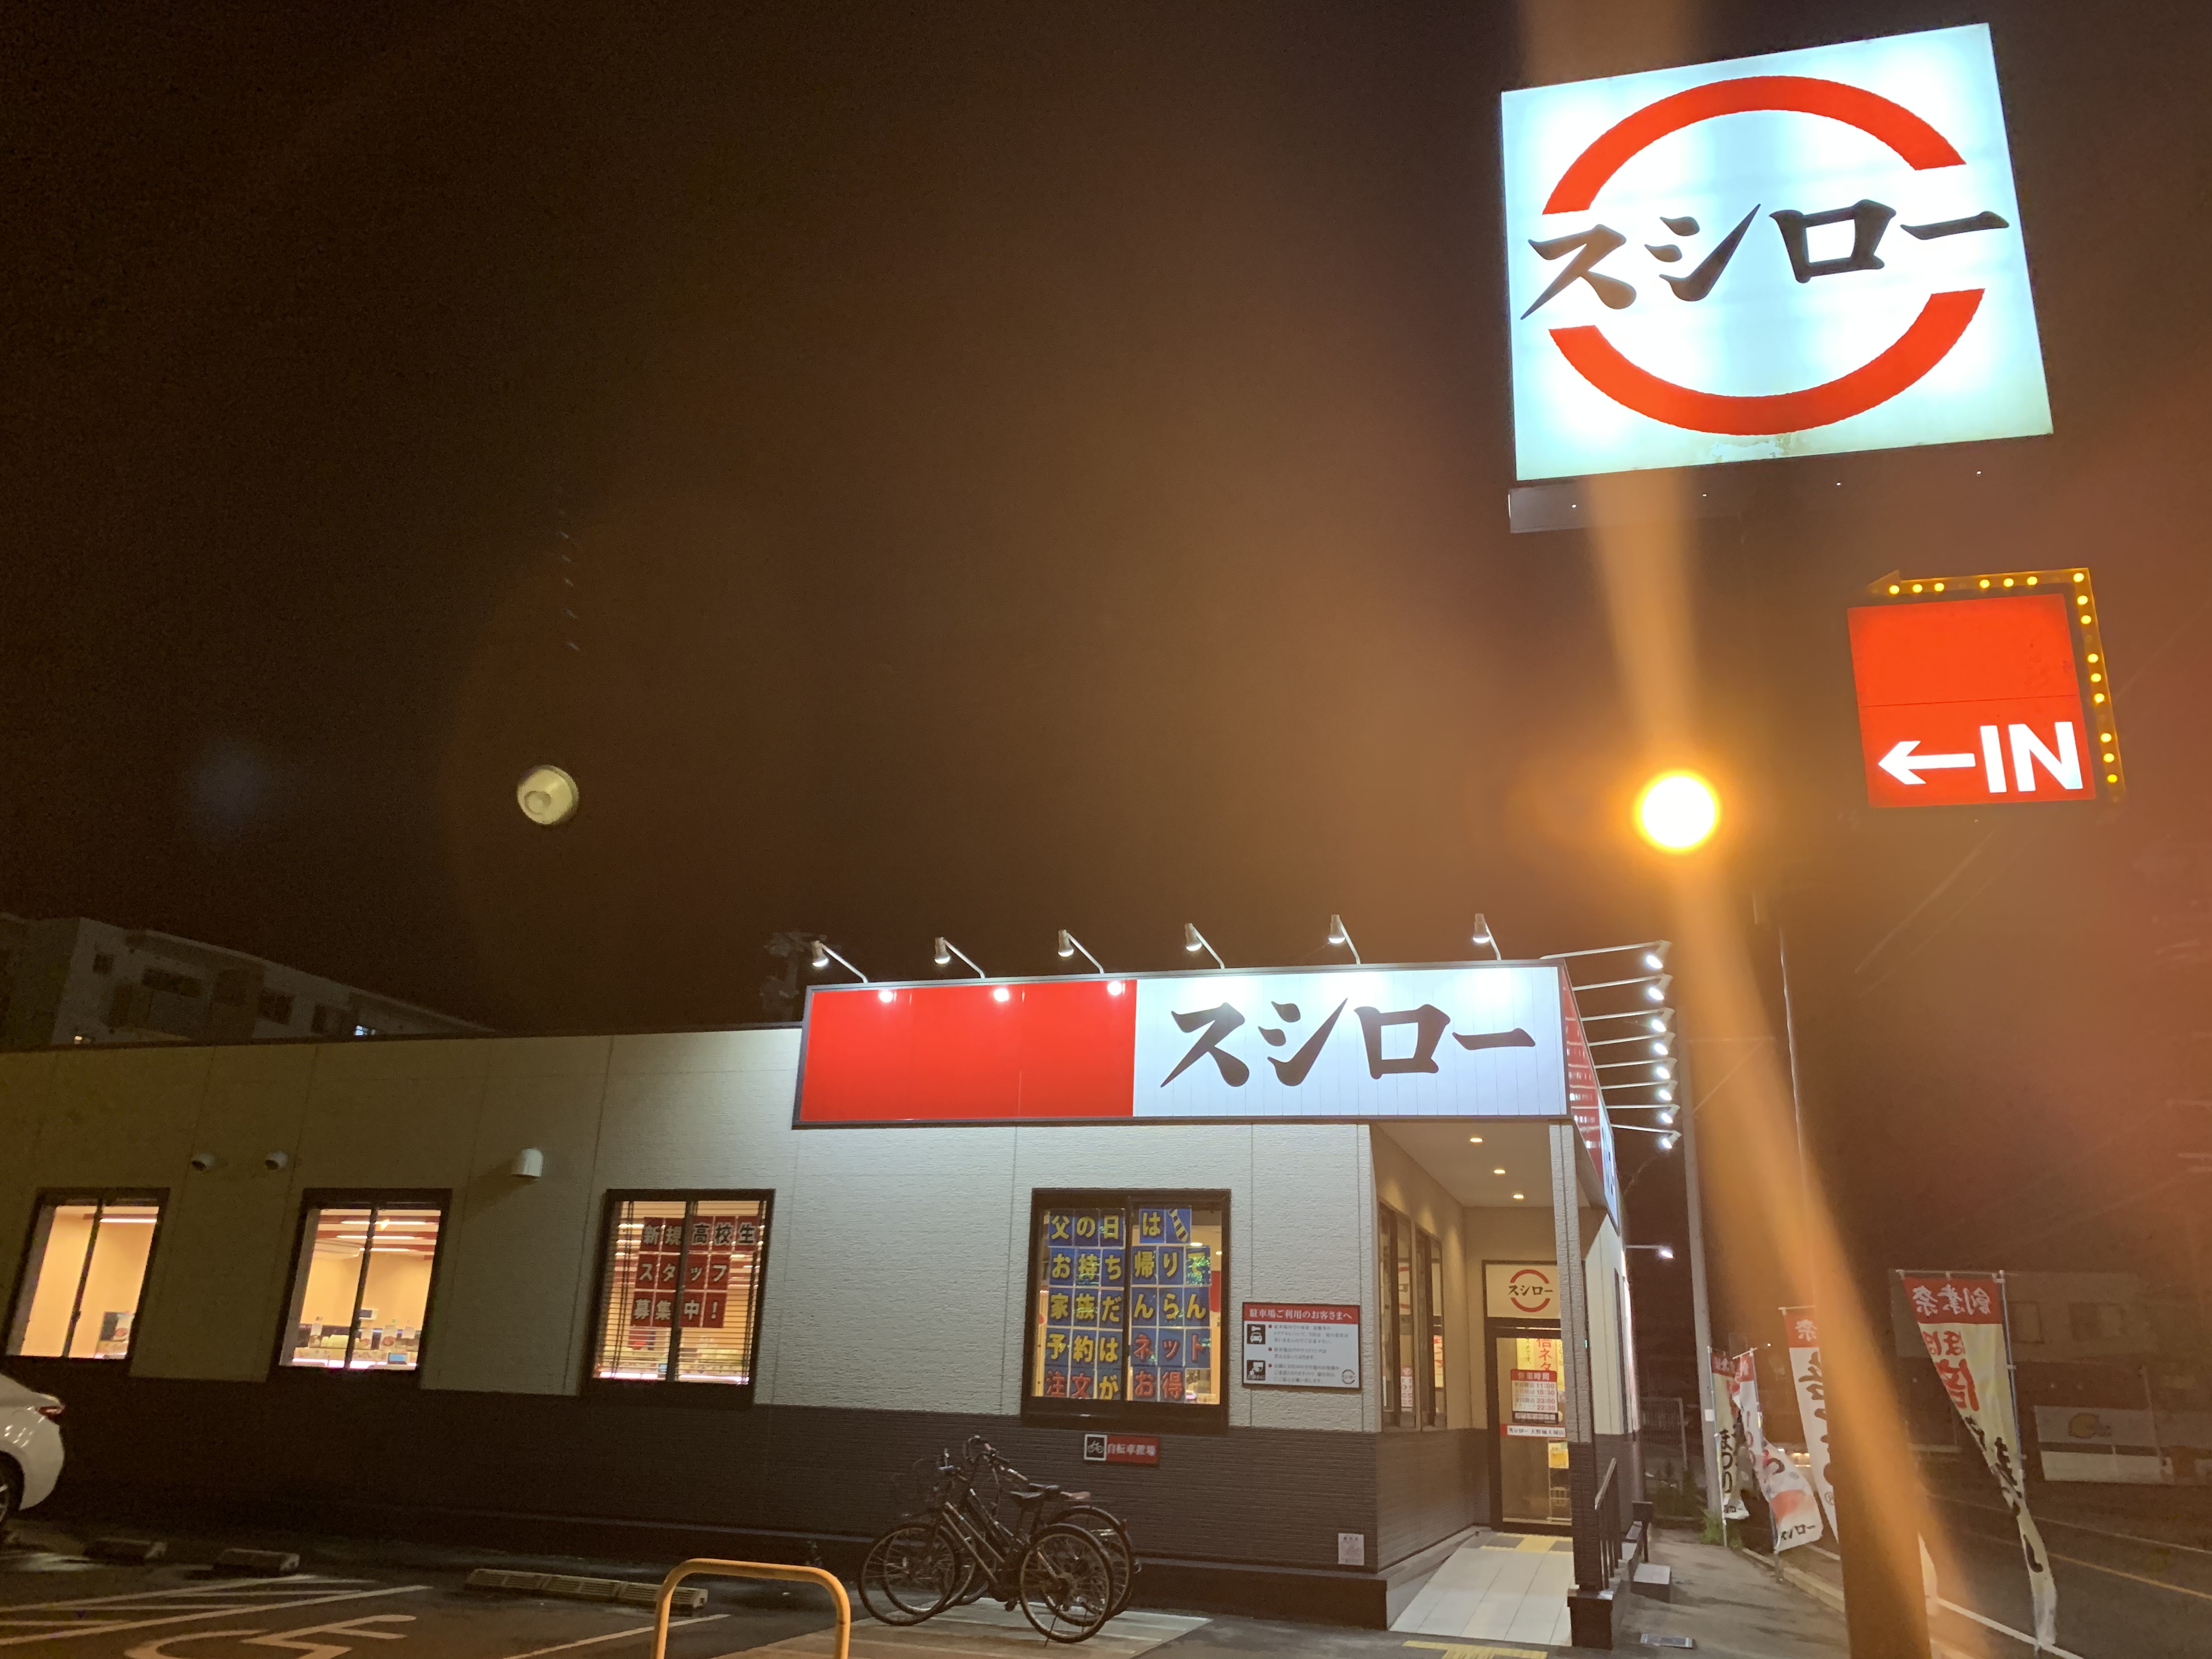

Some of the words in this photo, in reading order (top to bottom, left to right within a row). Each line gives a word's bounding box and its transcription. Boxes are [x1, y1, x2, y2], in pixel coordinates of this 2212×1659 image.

[1520, 199, 2009, 320] スシロー
[1979, 721, 2083, 793] IN
[1160, 997, 1536, 1087] スシロー
[638, 1263, 727, 1282] スタッフ
[1508, 1285, 1553, 1296] スシロー
